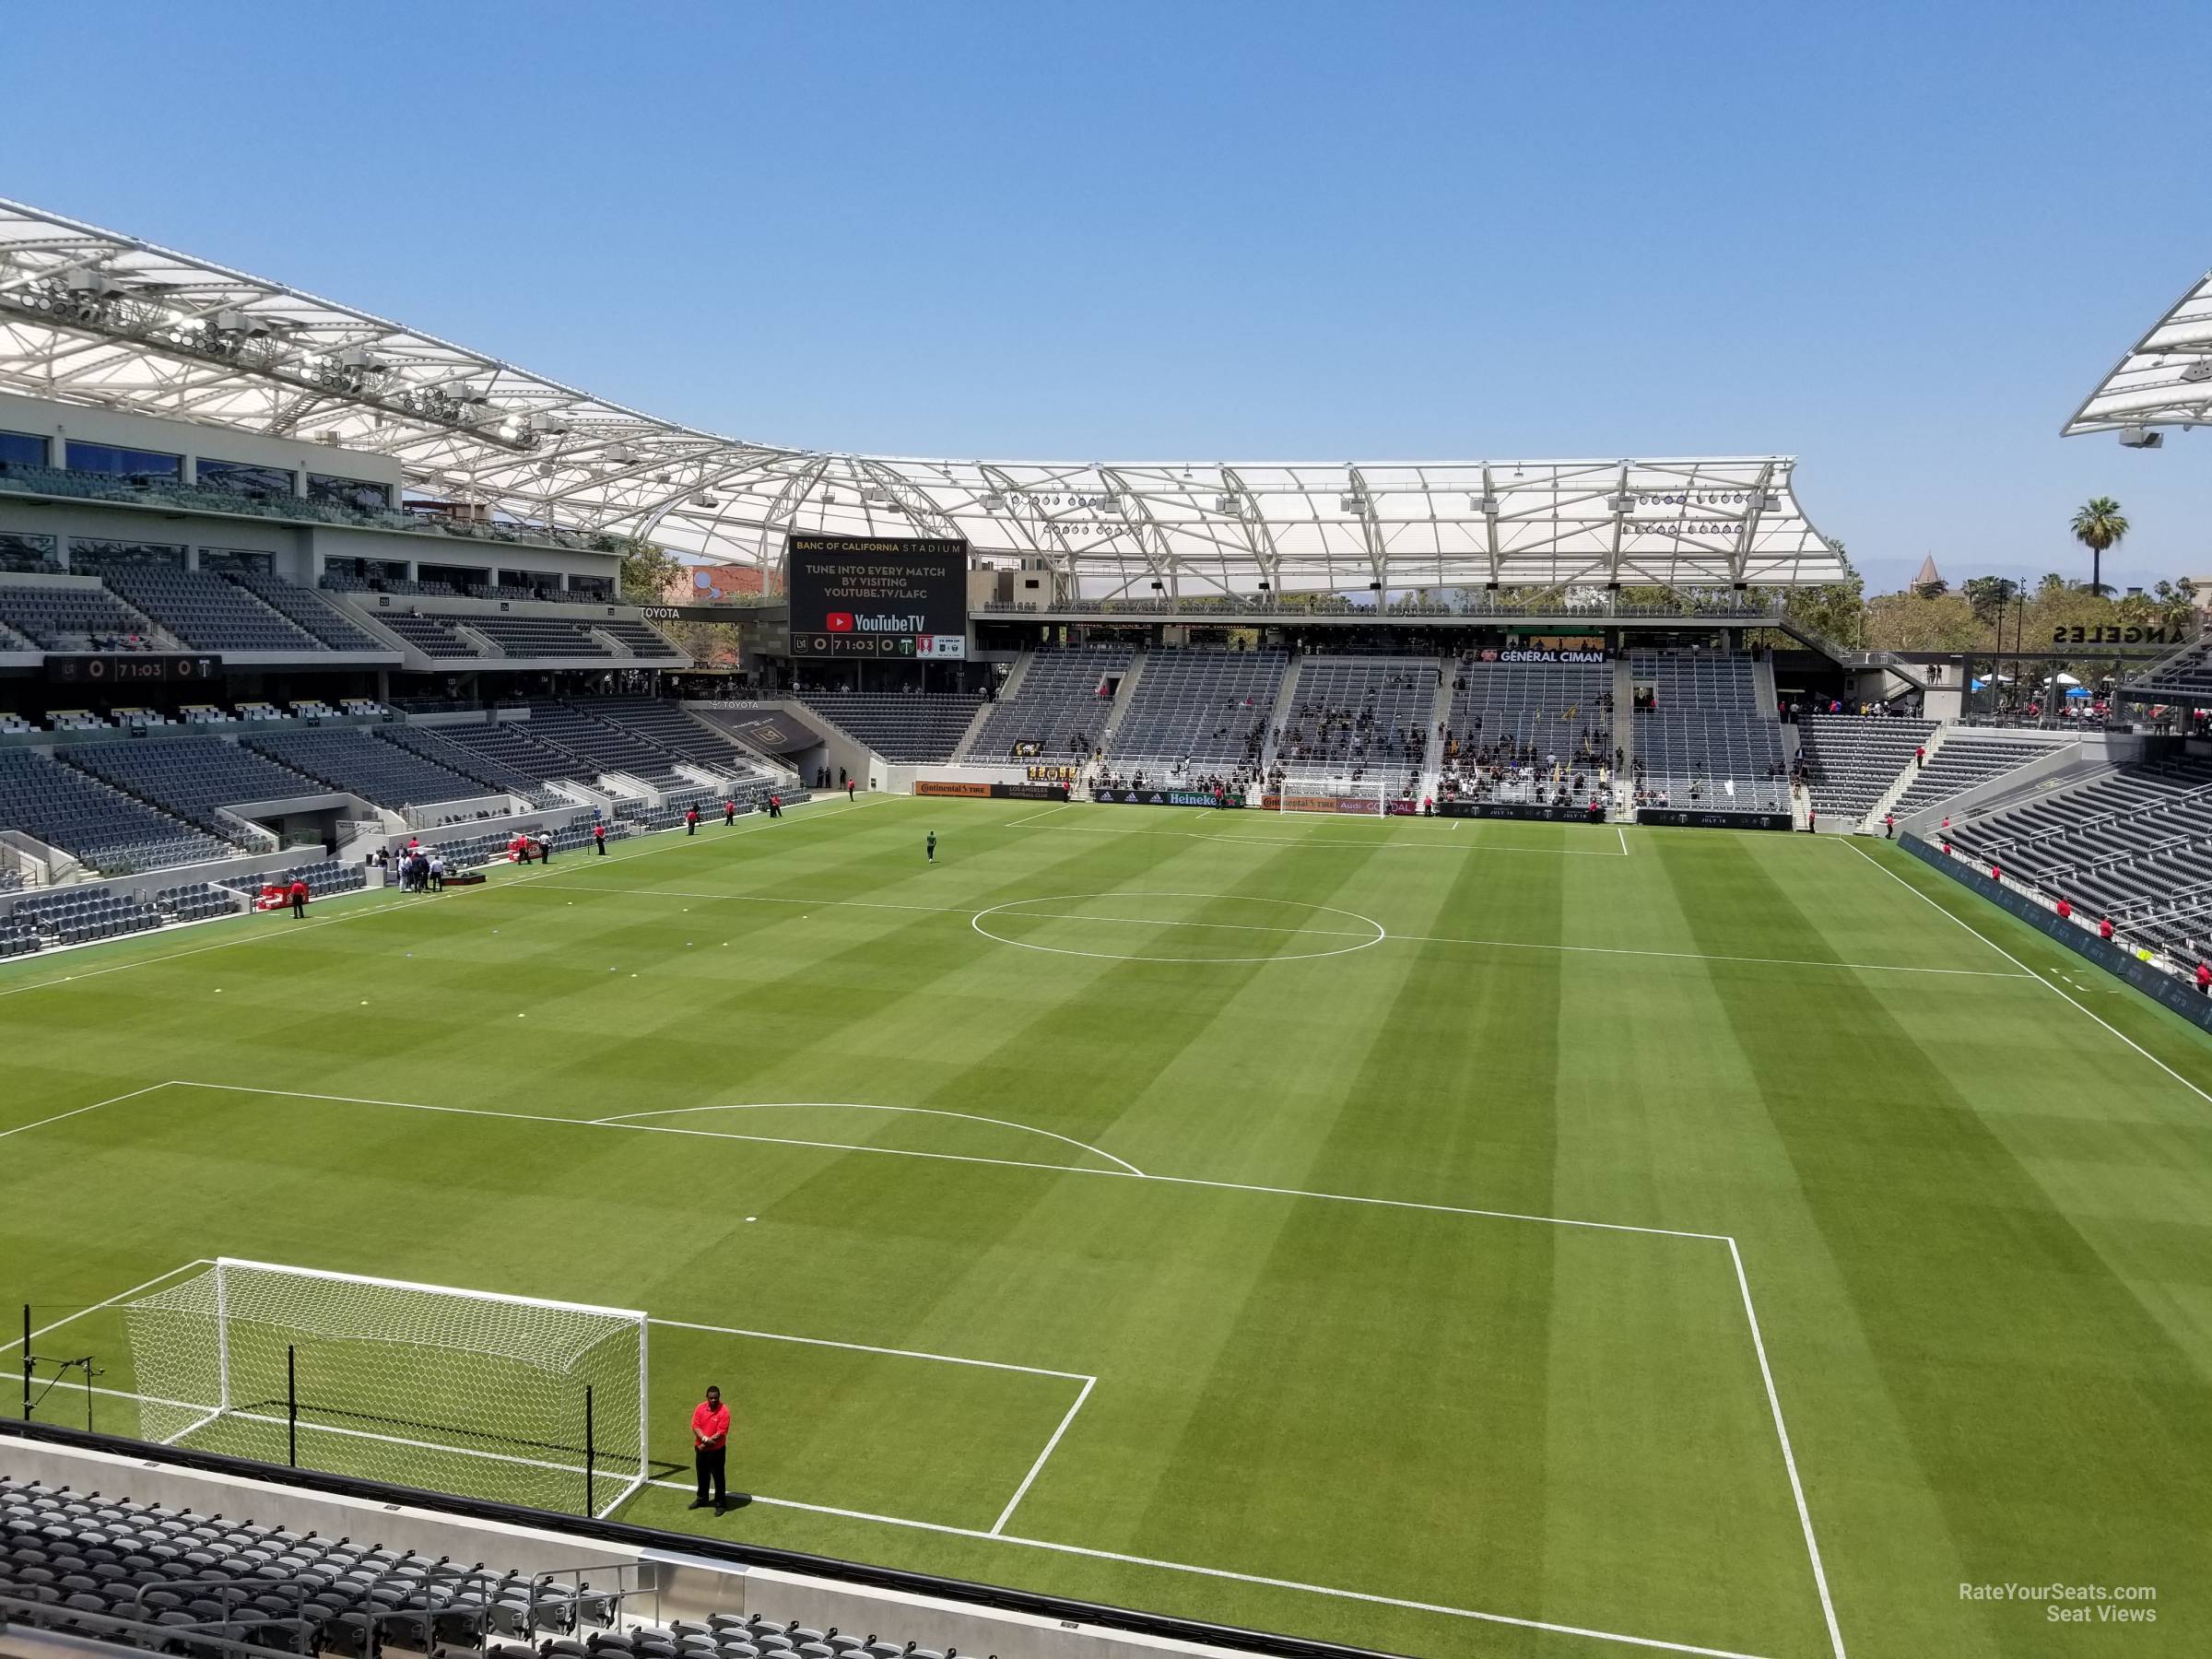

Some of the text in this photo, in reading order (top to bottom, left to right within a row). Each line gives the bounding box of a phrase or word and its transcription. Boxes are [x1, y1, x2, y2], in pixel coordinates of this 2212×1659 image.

[796, 541, 960, 553] BANC OF CALIFORNIA STADIUM
[805, 564, 946, 577] TUNE INTO EVERY MATCH
[841, 576, 908, 587] BY VISITING
[824, 588, 928, 598] YOUTUBE.TV/LAFC
[641, 607, 680, 619] TOYOTA
[814, 638, 827, 650] 0
[834, 640, 875, 651] 71:03
[881, 639, 894, 652] 0
[1500, 649, 1604, 663] GÉNÉRAL CIMAN
[89, 660, 104, 677] 0
[119, 664, 162, 677] 71:03
[178, 660, 191, 676] 0
[921, 783, 961, 794] Continental
[1170, 793, 1218, 806] Heineke
